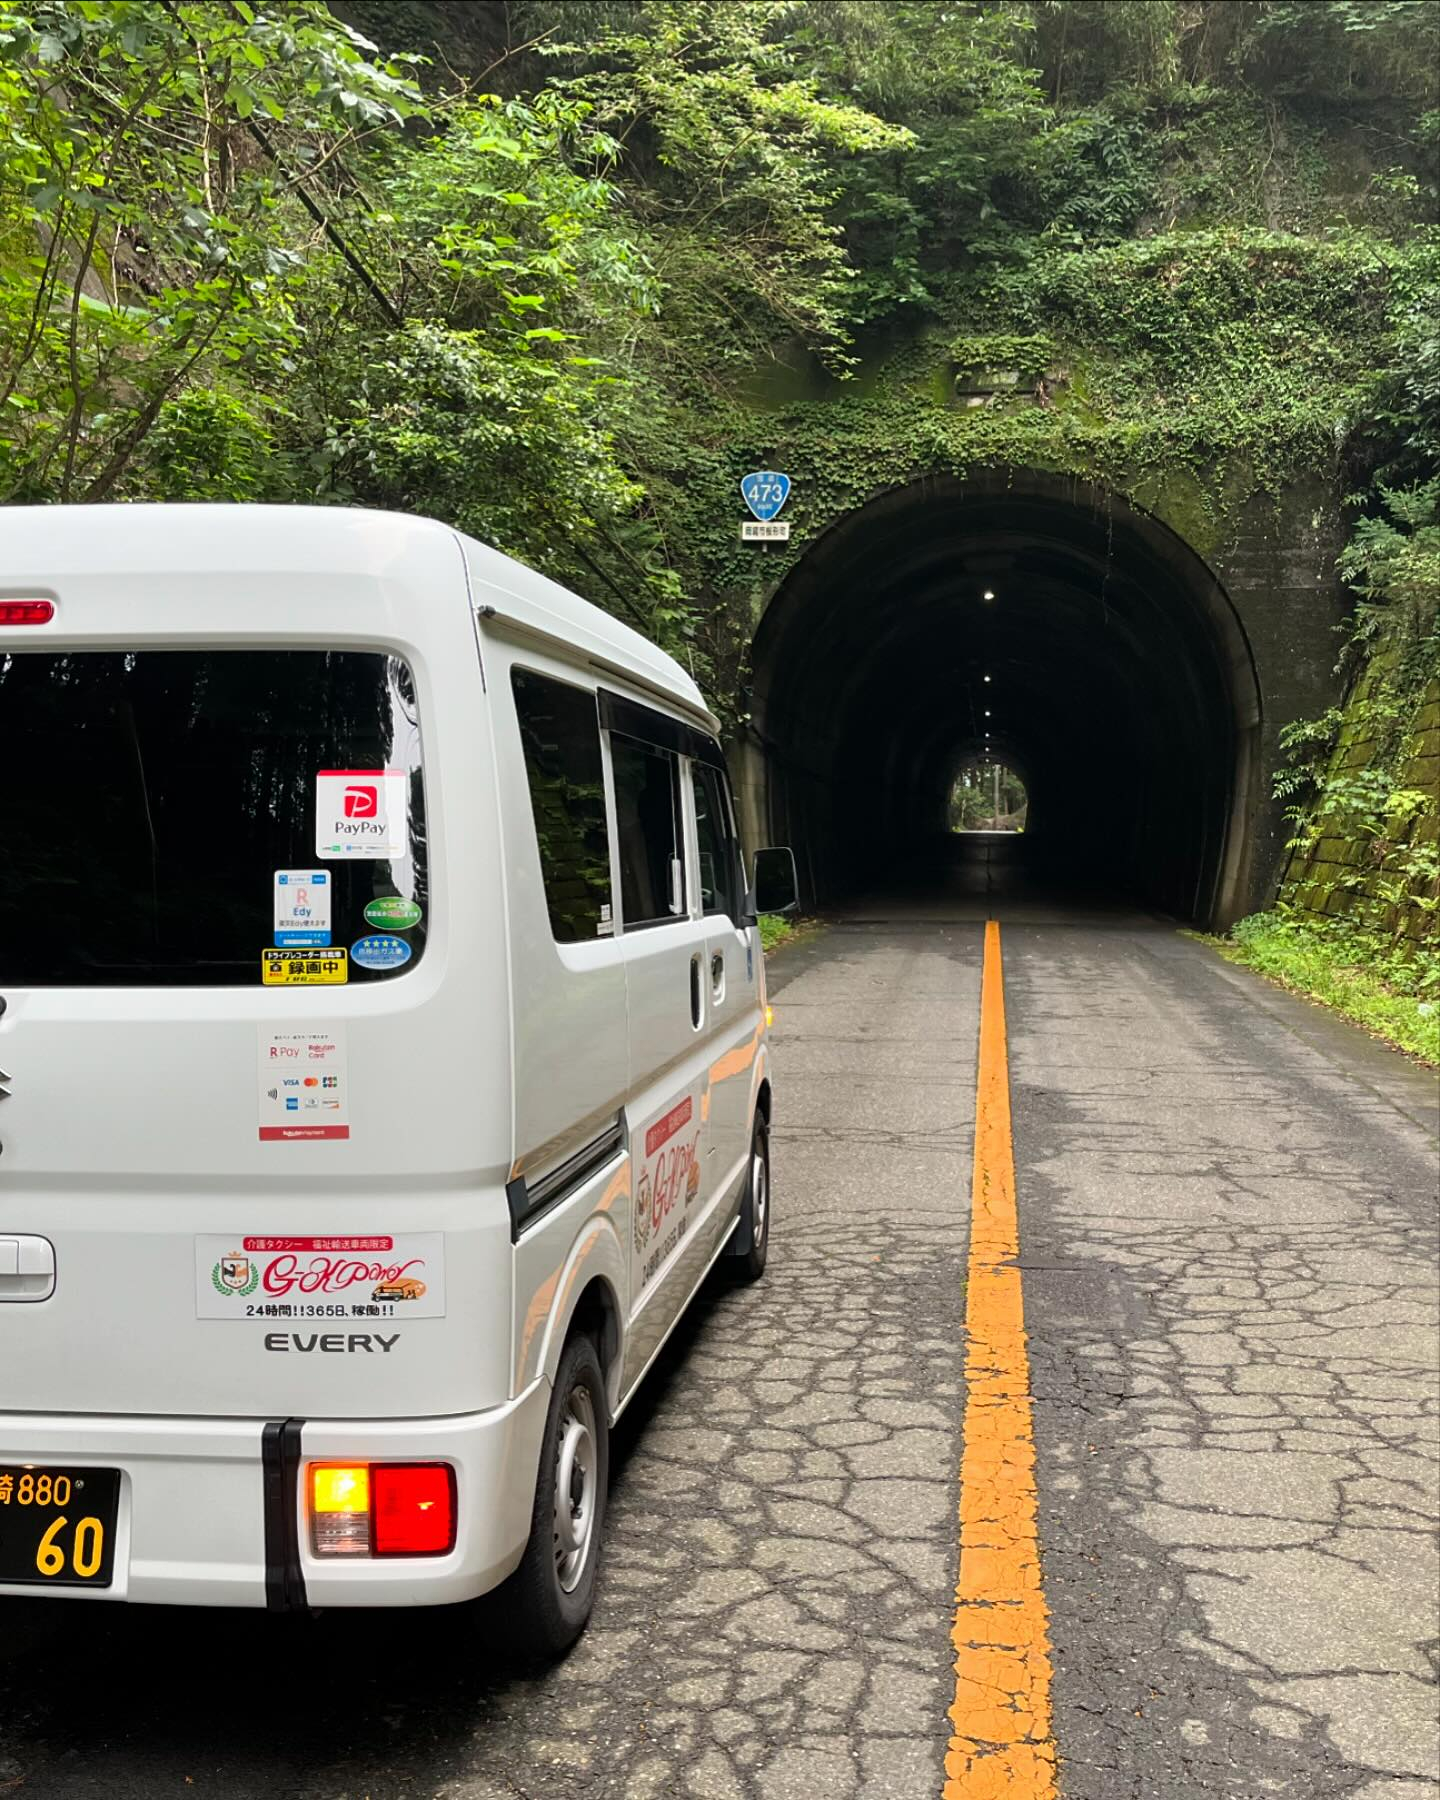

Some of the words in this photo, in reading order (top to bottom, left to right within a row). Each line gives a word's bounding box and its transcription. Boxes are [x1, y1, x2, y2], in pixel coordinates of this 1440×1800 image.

[748, 484, 783, 502] 473
[335, 822, 386, 835] PayPay
[293, 907, 312, 917] Edy
[288, 960, 338, 975] 録画中
[280, 1047, 300, 1058] Pay
[282, 1079, 300, 1087] VISA
[246, 1239, 303, 1249] 介護タクシー
[312, 1238, 390, 1250] 福祉輸送車両限定
[264, 1333, 401, 1353] EVERY
[17, 1474, 71, 1506] 880
[36, 1516, 104, 1577] 60
